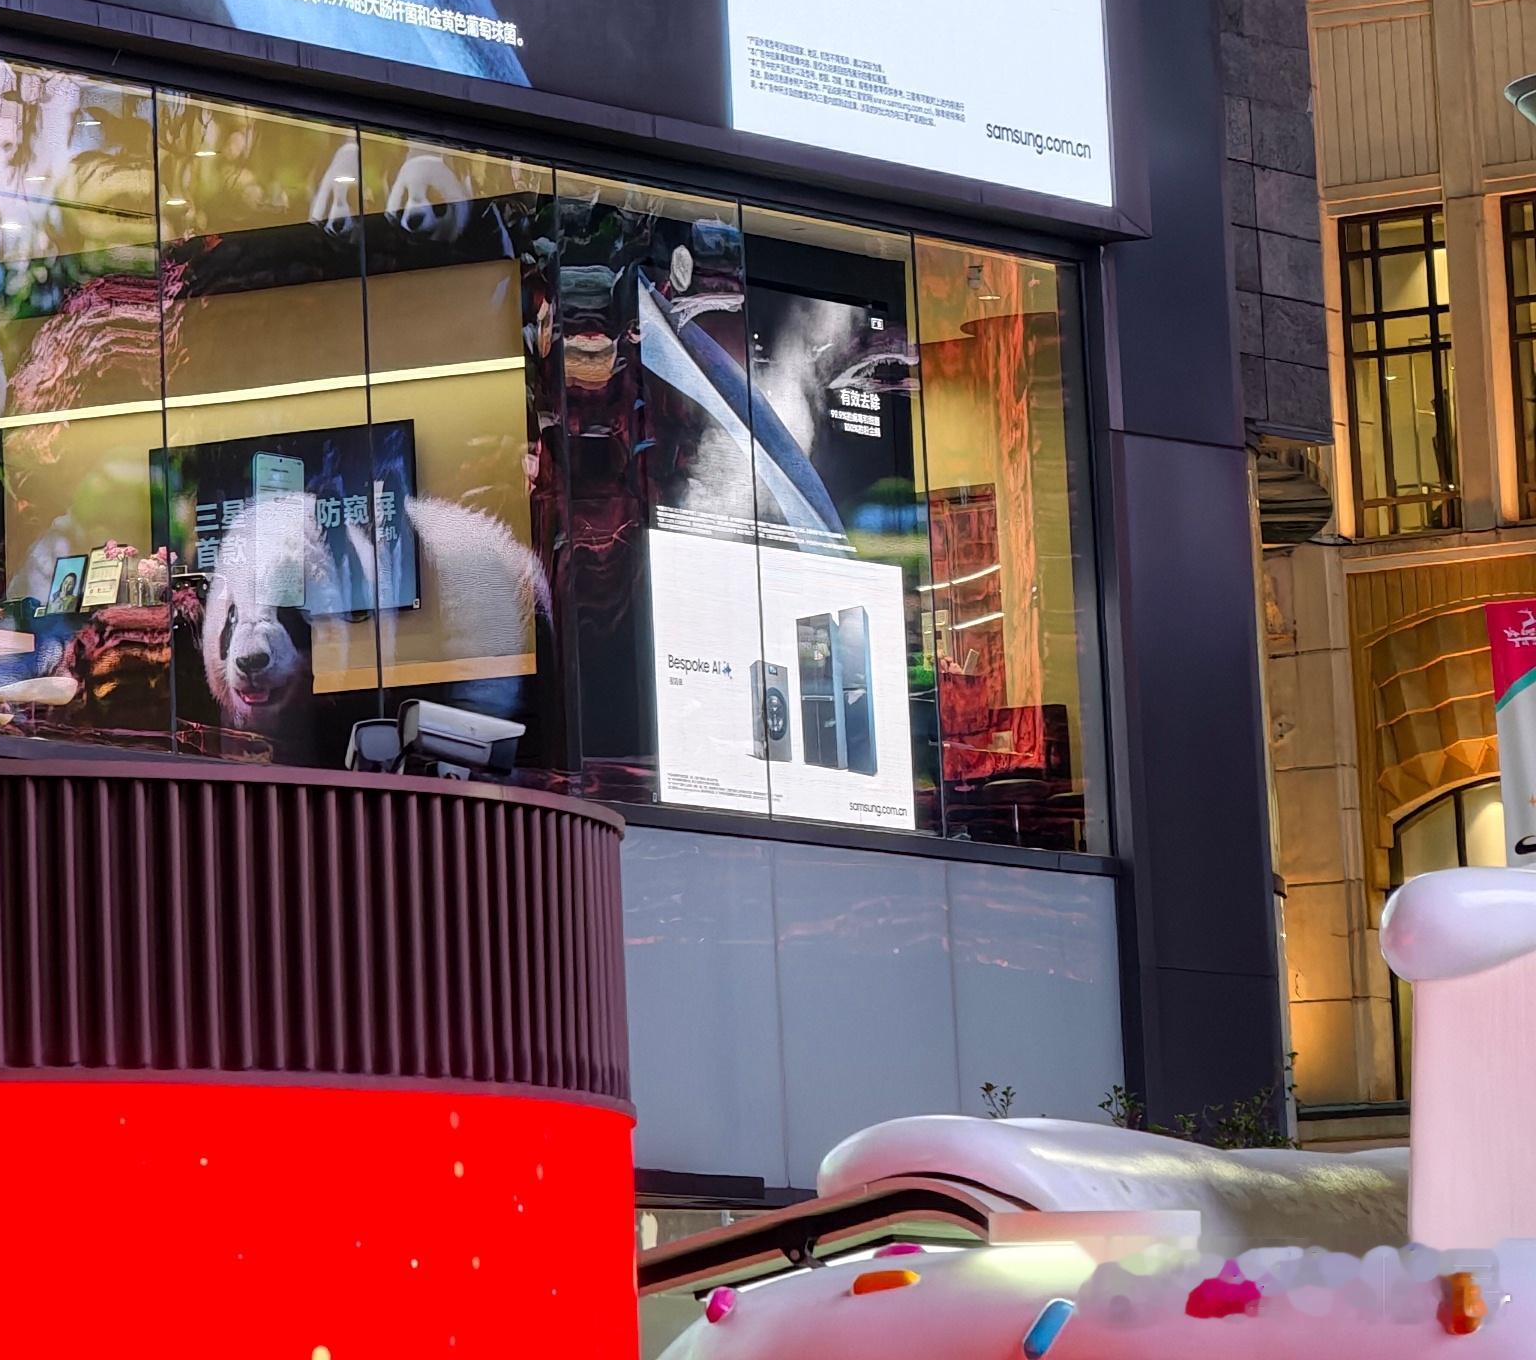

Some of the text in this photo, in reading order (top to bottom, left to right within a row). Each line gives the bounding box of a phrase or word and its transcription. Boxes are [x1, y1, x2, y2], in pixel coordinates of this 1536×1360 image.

[985, 122, 1092, 159] samsung.com.cn
[667, 654, 710, 675] Bespoke
[848, 801, 908, 817] samsung.com.cn
